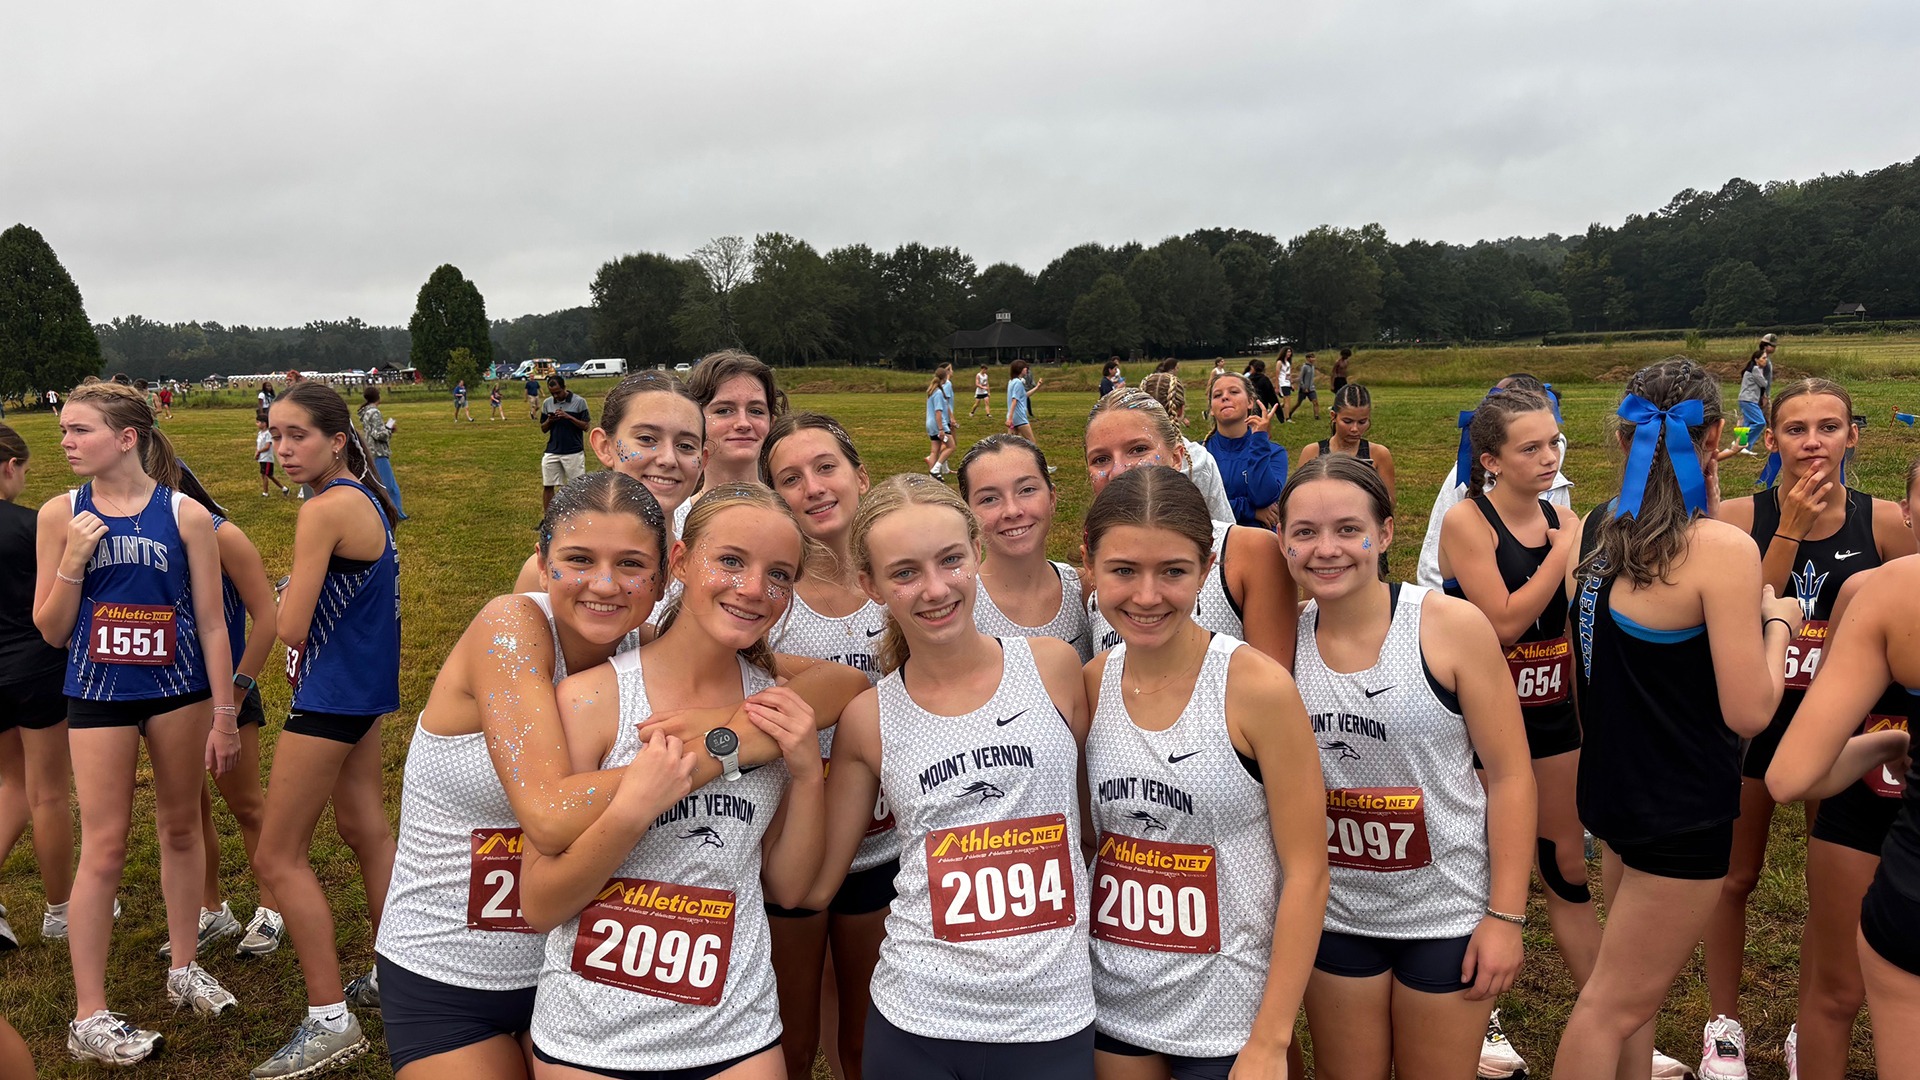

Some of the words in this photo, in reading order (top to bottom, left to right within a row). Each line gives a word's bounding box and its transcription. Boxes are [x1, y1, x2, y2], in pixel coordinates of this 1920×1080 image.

[97, 626, 168, 657] 1551
[1101, 630, 1123, 652] MOU
[1517, 663, 1562, 698] 654
[1310, 713, 1333, 733] UNT
[1338, 713, 1387, 742] VERNON
[918, 753, 967, 795] MOUNT
[971, 745, 1034, 769] VERNON
[705, 794, 756, 825] VERNON
[1098, 777, 1137, 805] MOUNT
[1142, 778, 1193, 815] VERNON
[941, 858, 1067, 926] 2094
[1097, 874, 1208, 938] 2090
[585, 918, 722, 988] 2096
